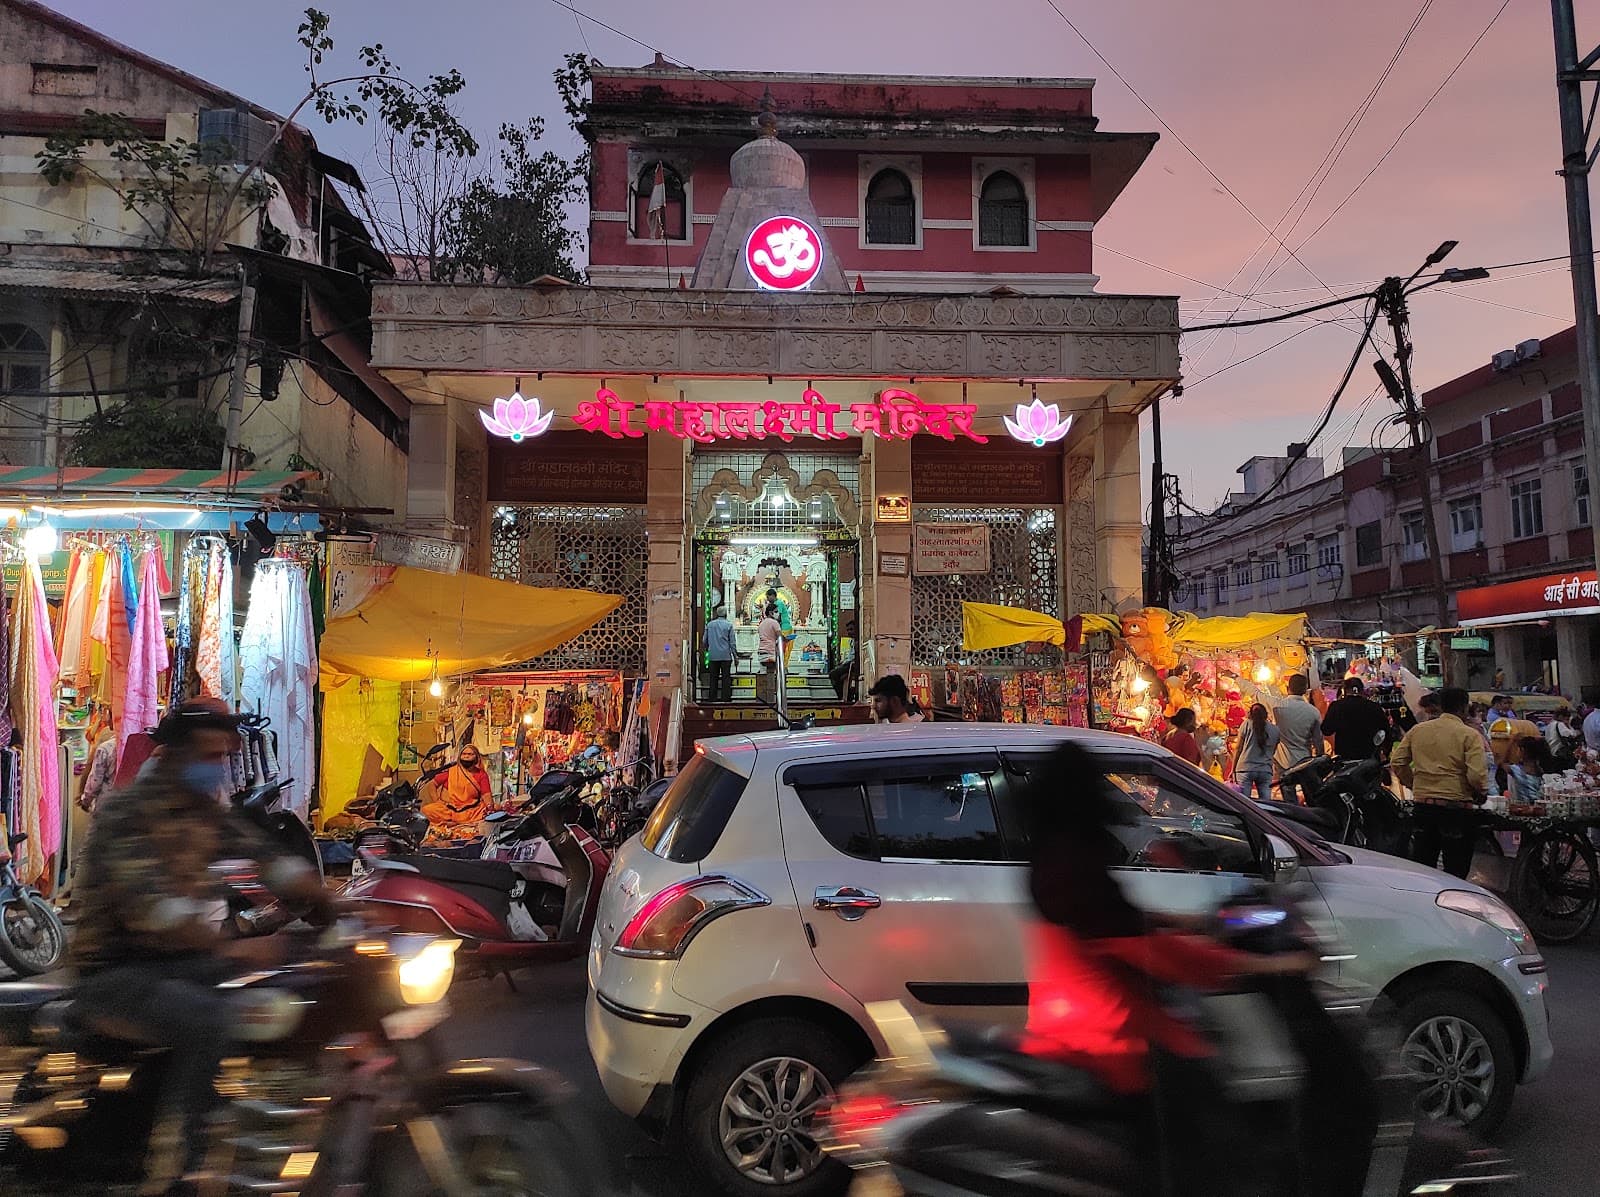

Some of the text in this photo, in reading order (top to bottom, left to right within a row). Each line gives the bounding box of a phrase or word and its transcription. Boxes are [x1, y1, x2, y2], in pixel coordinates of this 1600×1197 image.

[571, 388, 990, 445] श्री महालक्ष्मी मन्दिर
[1544, 579, 1566, 604] आई
[1566, 576, 1580, 600] सी
